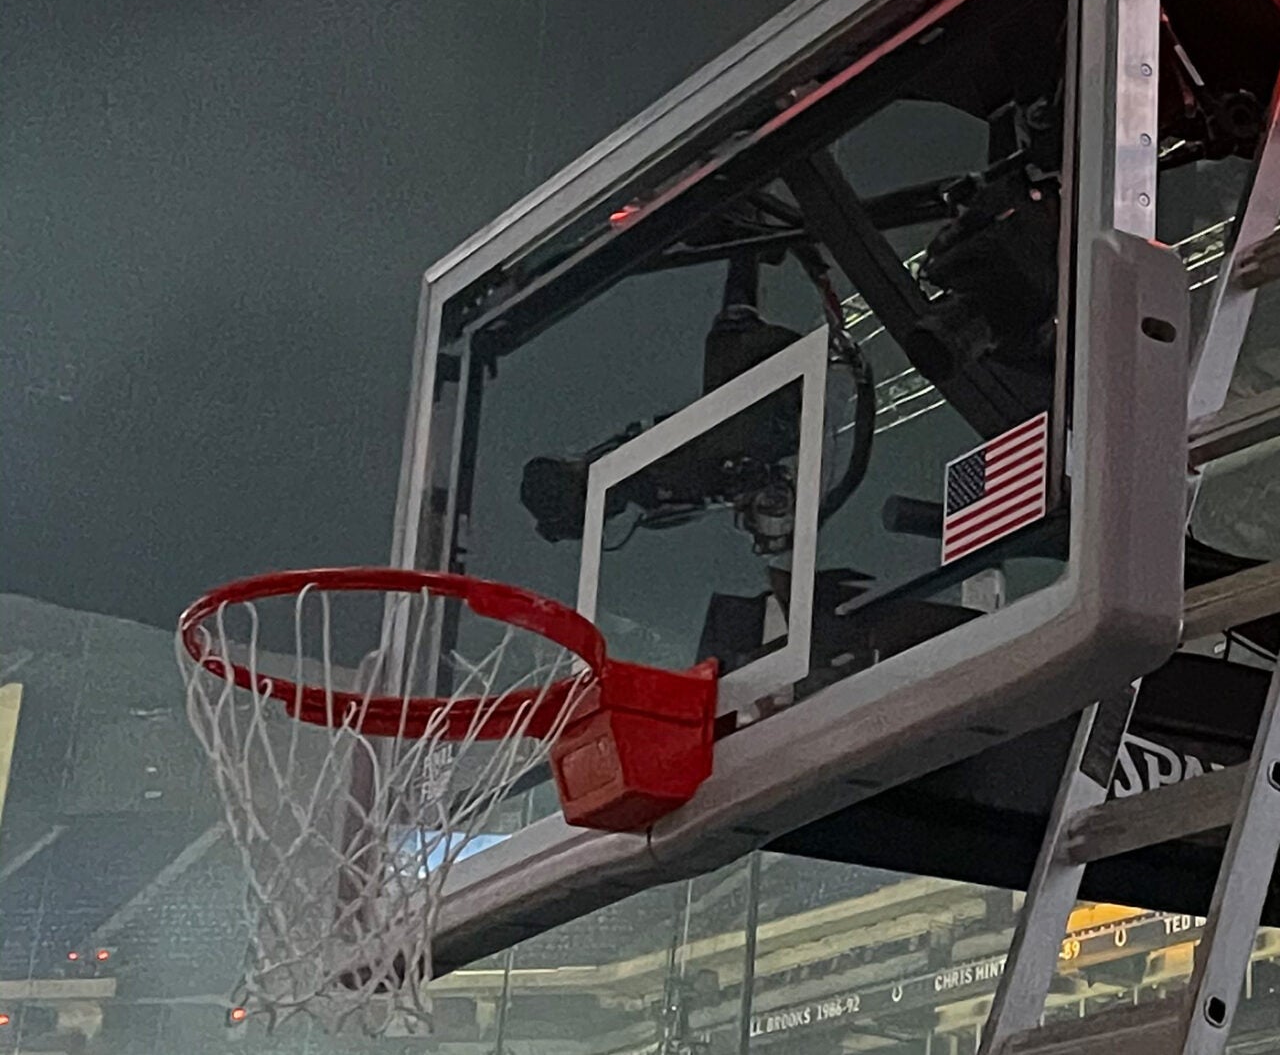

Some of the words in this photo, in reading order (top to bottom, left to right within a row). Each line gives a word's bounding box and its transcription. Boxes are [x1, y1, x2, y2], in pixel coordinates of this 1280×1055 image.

[1164, 915, 1190, 935] TED
[934, 967, 973, 992] CHRIS
[766, 1007, 811, 1034] BROOKS
